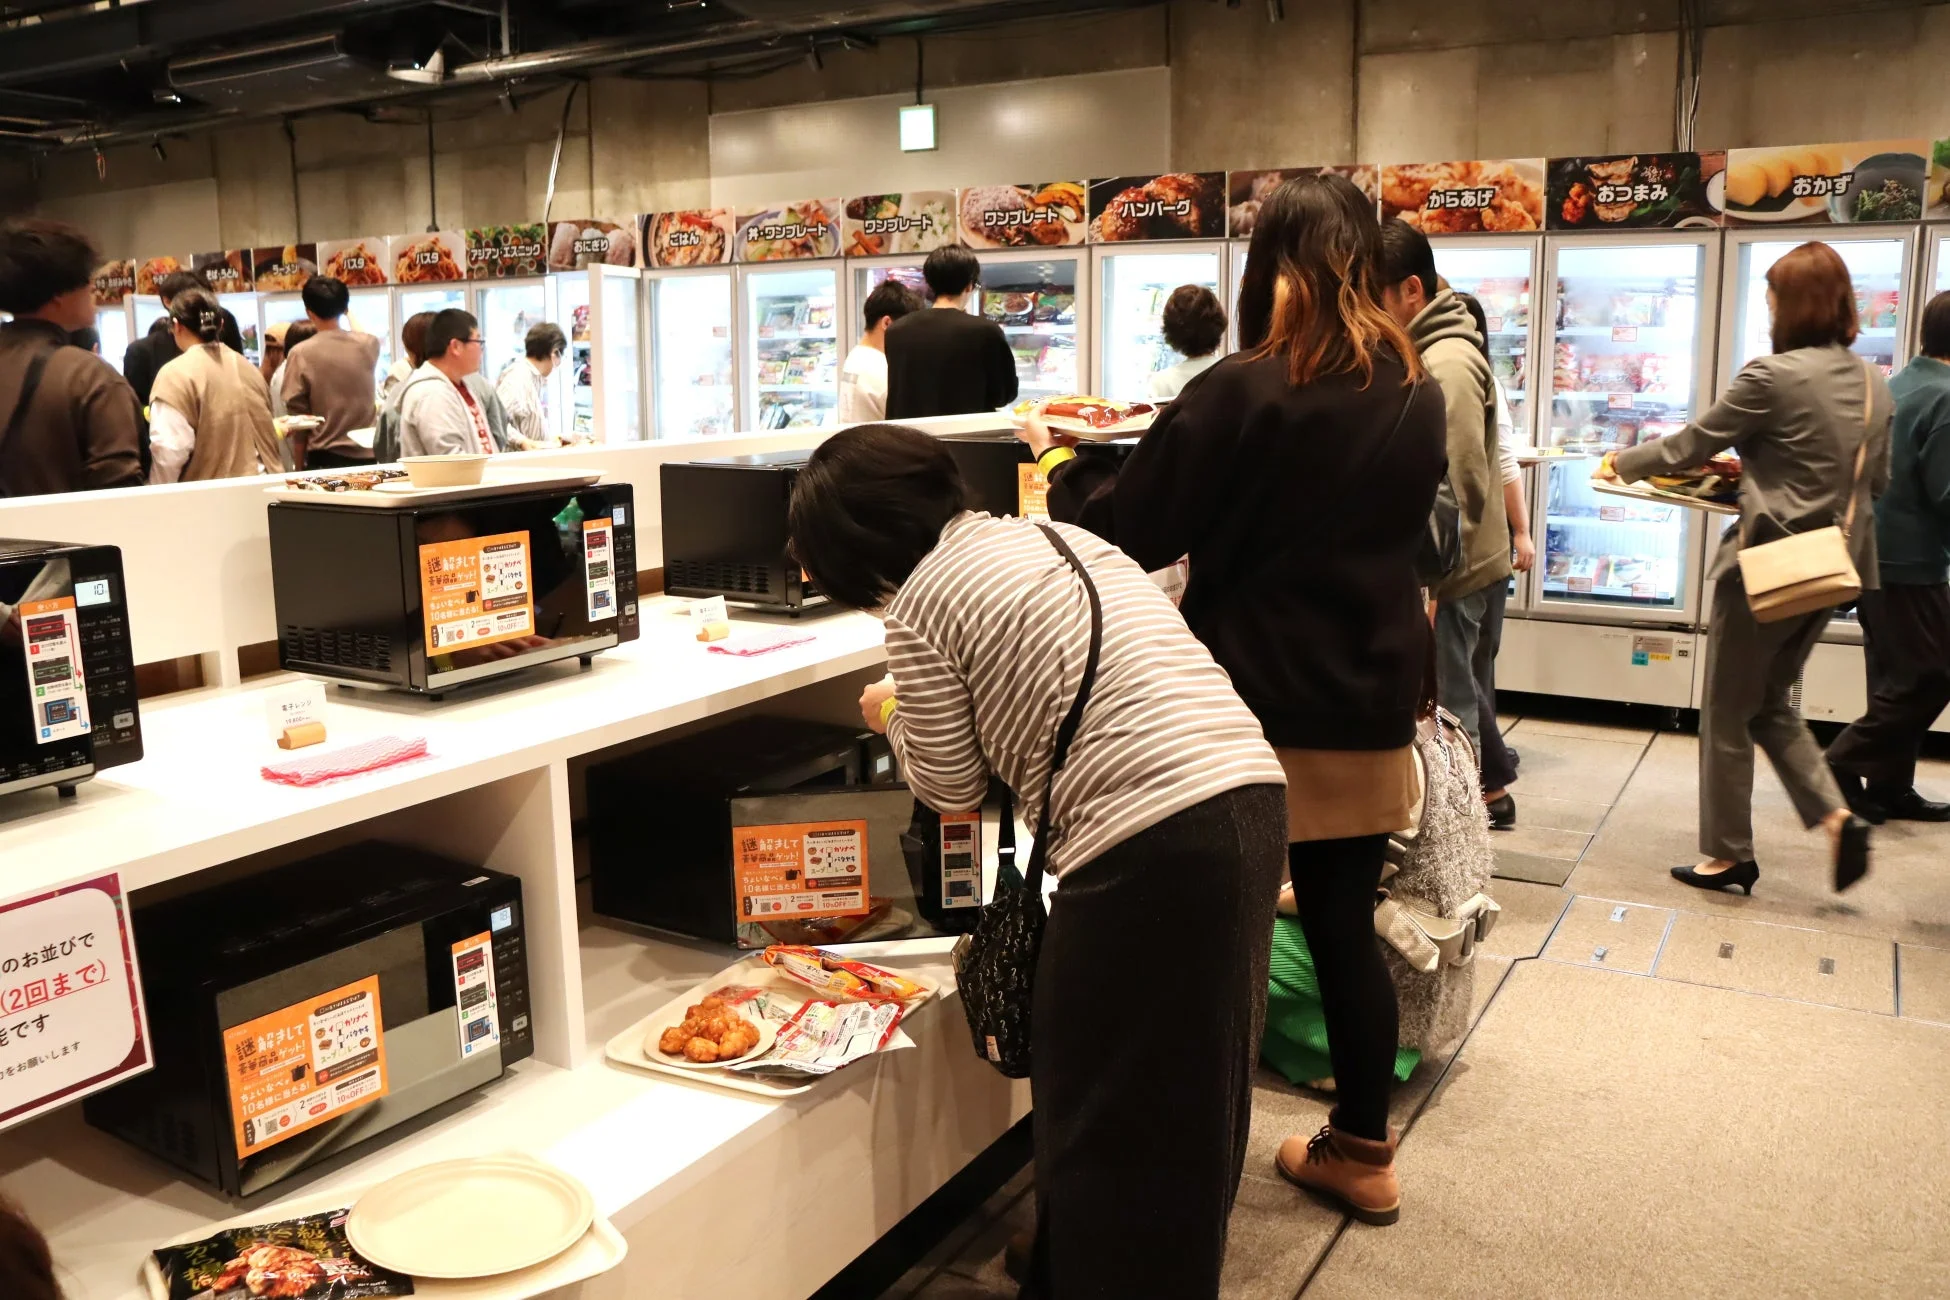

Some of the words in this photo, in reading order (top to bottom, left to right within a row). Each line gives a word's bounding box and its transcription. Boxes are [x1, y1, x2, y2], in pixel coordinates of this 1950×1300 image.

[1597, 184, 1668, 203] おつまみ
[1792, 174, 1853, 196] おかず
[1428, 189, 1494, 209] からあげ
[1121, 199, 1191, 217] ハンバーグ
[864, 215, 933, 234] ワンプレート
[984, 209, 1059, 227] ワンプレート
[669, 231, 700, 247] ごはん
[747, 223, 828, 241] 丼・ワンプレート
[470, 243, 541, 260] アジアン・エスニック
[573, 238, 610, 253] おにぎり
[343, 256, 365, 270] パスタ
[415, 251, 439, 265] パスタ
[205, 269, 239, 281] そば・うどん
[271, 263, 298, 276] ラーメン
[427, 555, 477, 574] 謎解きして
[281, 700, 312, 712] 電子レンジ
[741, 838, 799, 852] 謎解きして
[790, 895, 796, 903] 2
[2, 932, 95, 974] のお並びで
[0, 958, 106, 1015] (2回まで)
[236, 1022, 305, 1062] 謎解きして
[242, 1080, 311, 1116] 10名様に当たる!
[337, 1087, 364, 1104] 10%OFF
[299, 1100, 306, 1110] 2
